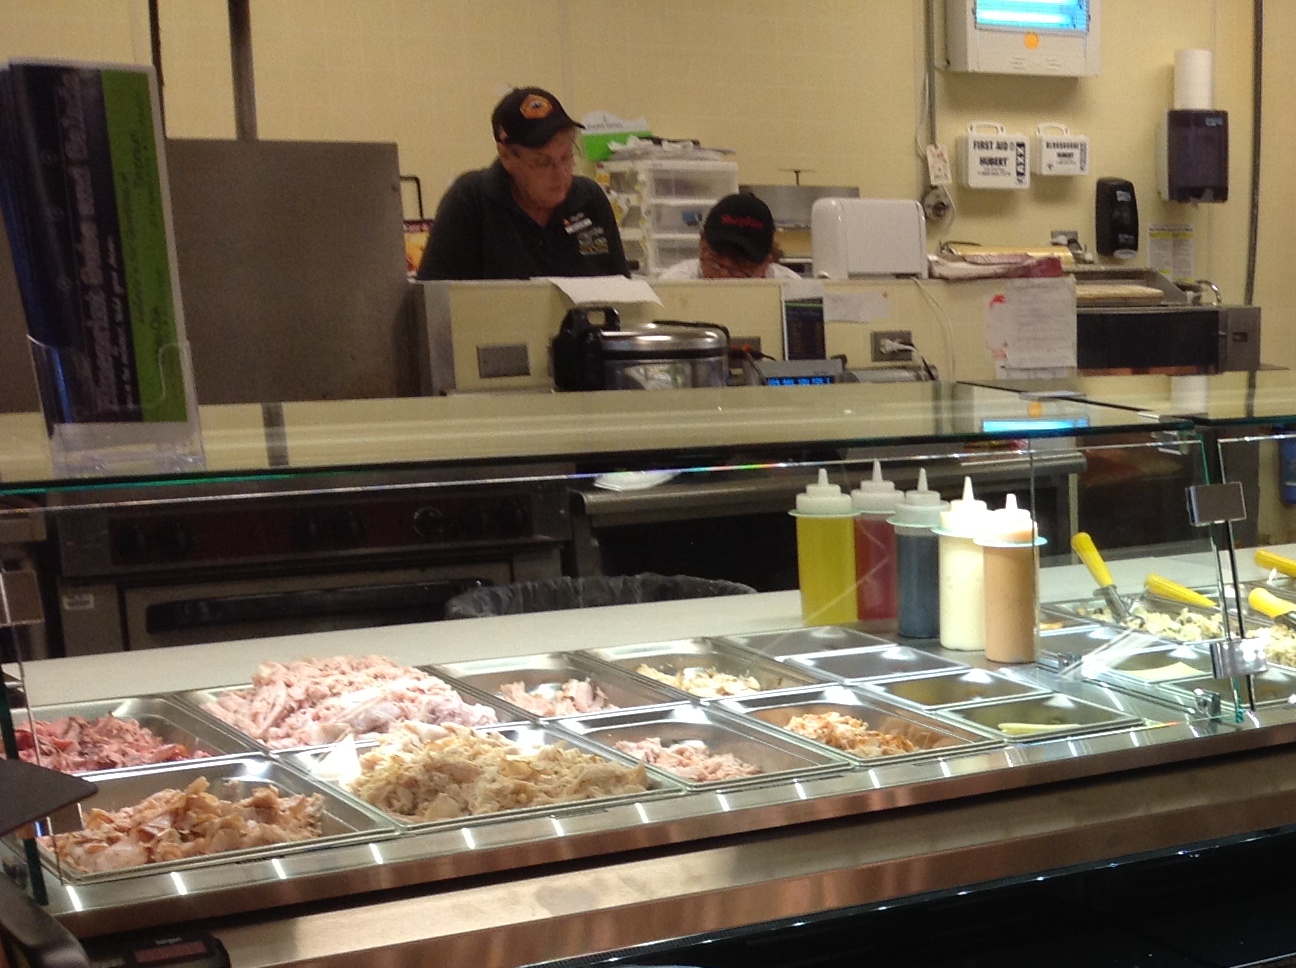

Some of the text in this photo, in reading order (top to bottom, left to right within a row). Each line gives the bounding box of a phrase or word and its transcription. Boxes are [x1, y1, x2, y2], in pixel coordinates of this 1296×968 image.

[973, 141, 1008, 151] FIRST AID
[980, 157, 1008, 166] HUBERT
